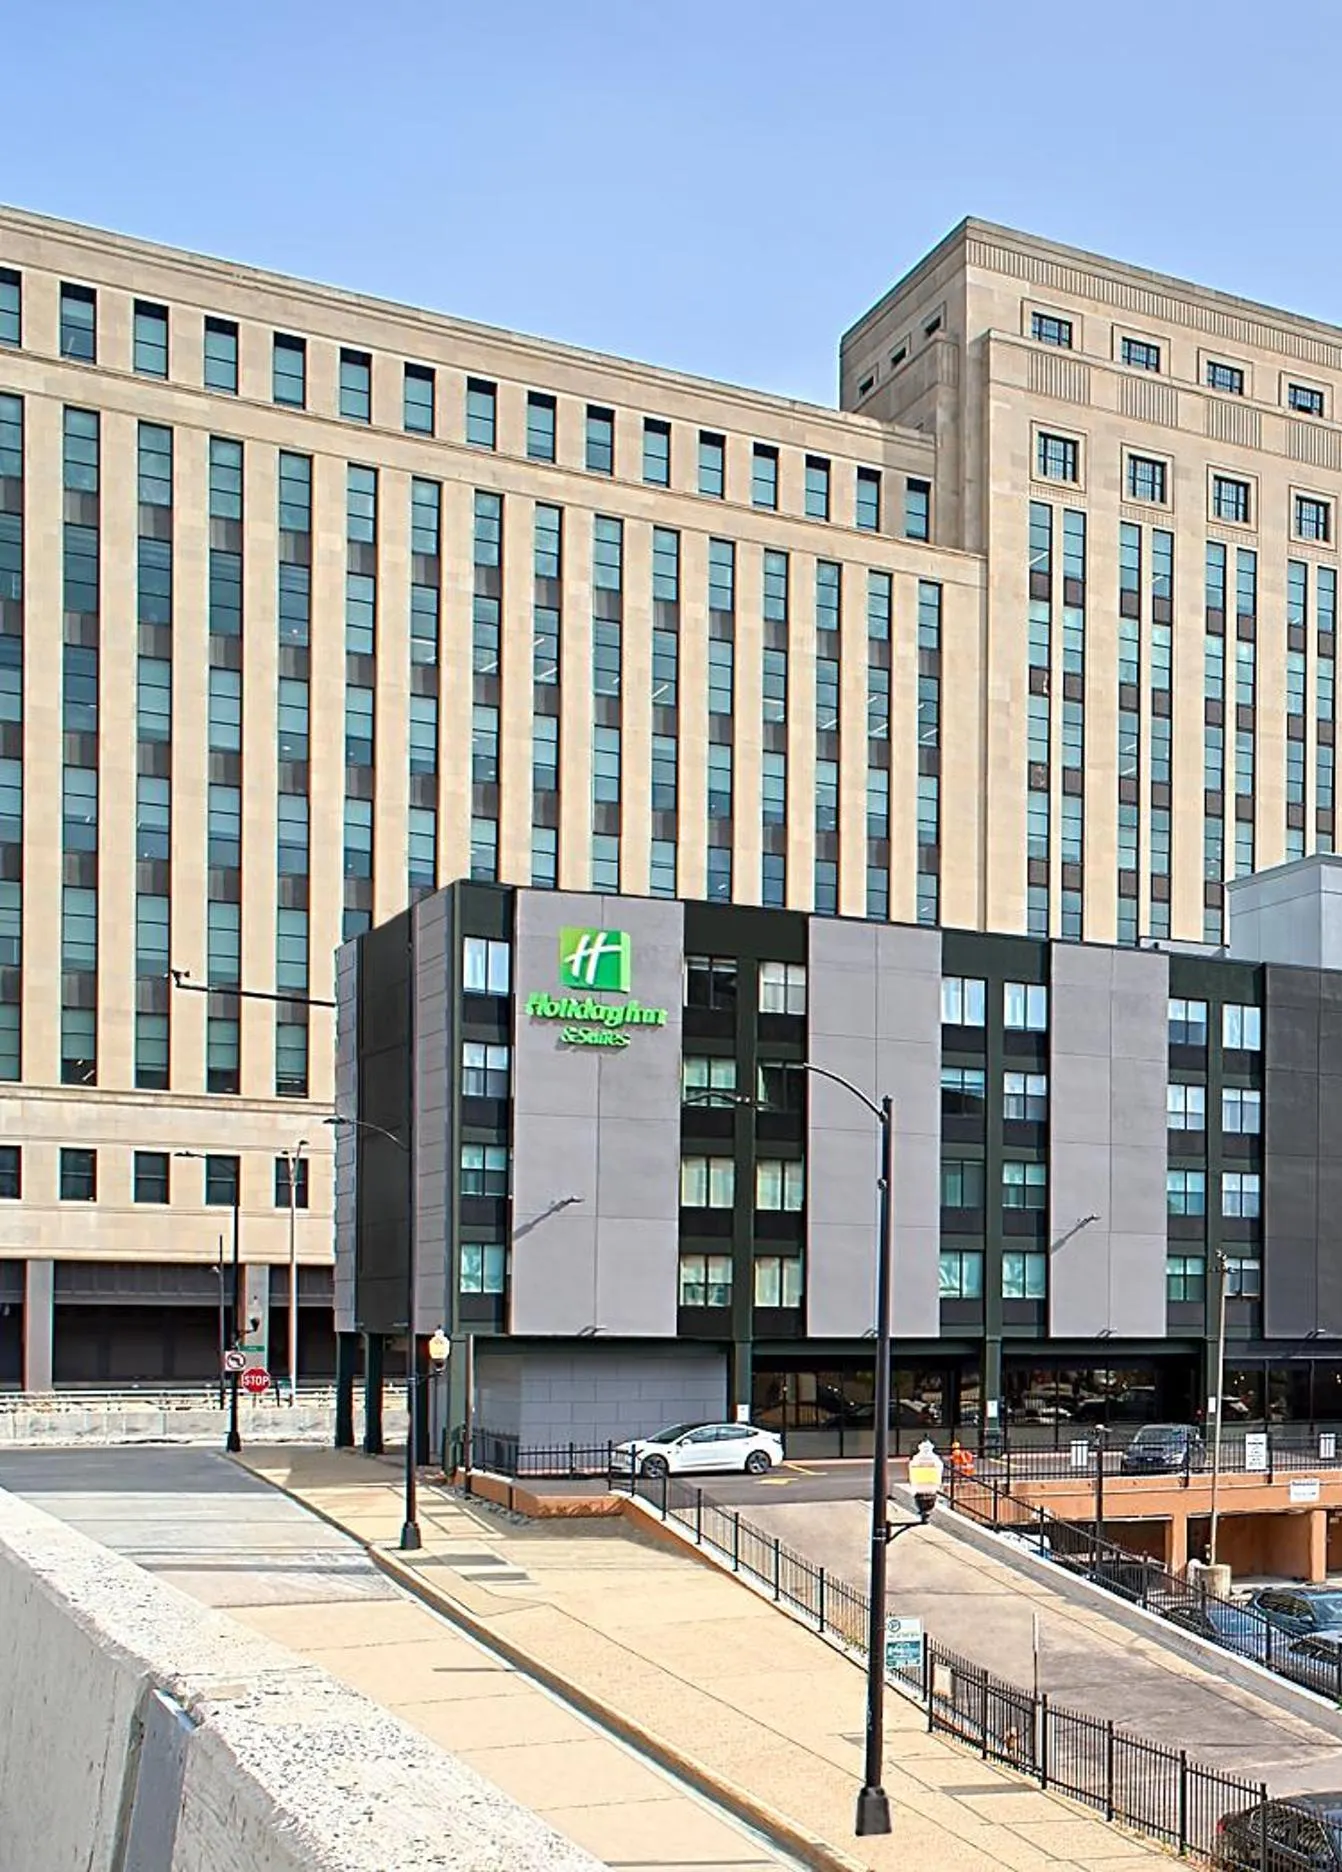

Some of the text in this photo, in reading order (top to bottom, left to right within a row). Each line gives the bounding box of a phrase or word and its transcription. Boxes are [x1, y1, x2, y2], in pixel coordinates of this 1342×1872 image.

[526, 992, 668, 1028] Holiday Inn
[243, 1375, 270, 1386] STOP
